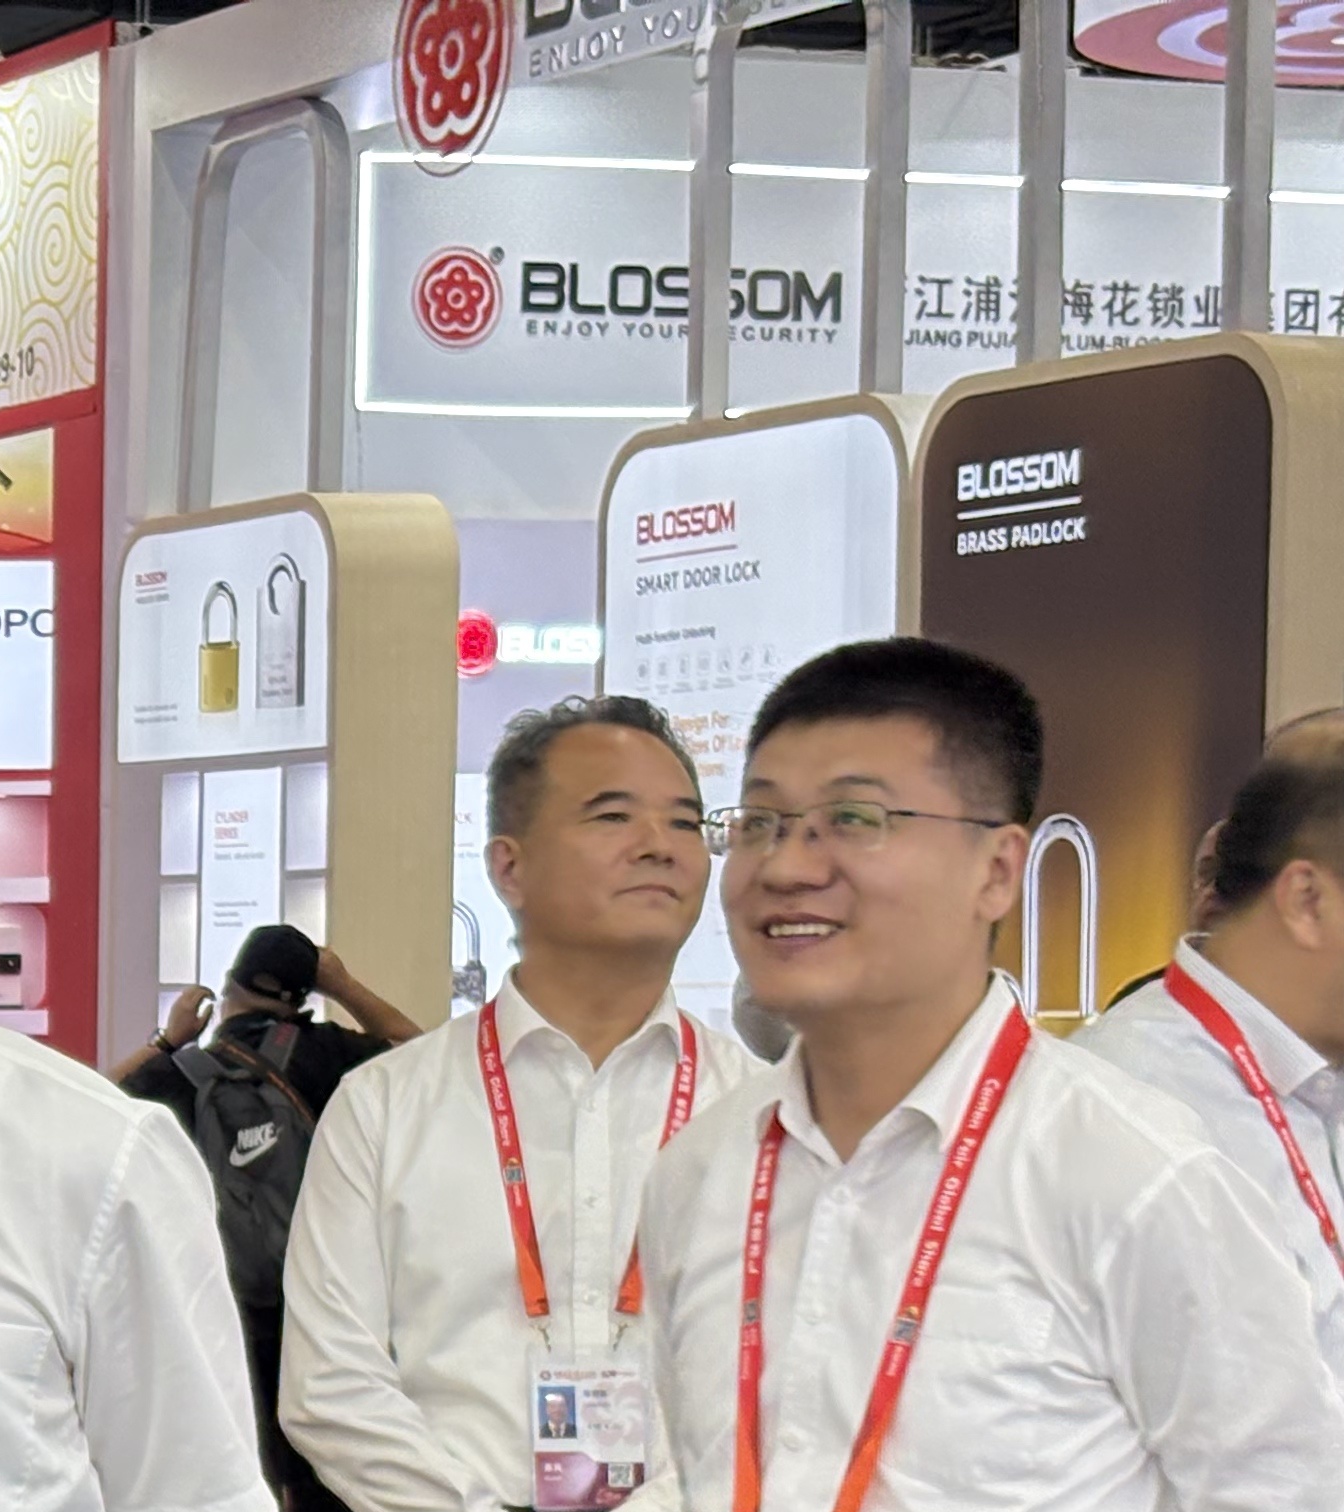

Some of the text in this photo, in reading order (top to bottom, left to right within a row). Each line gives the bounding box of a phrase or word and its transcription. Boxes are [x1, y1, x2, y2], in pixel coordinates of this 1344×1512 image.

[529, 26, 626, 79] ENJOY
[641, 2, 706, 45] YOU
[525, 319, 838, 343] ENJOY YOUR ECURITY
[967, 330, 1016, 350] PUJI
[957, 447, 1082, 501] BLOSSOM
[636, 500, 737, 546] BLOSSOM
[956, 516, 1086, 555] BRASS PADLOCK
[636, 560, 761, 597] SMART DOOR LOCK
[237, 1121, 275, 1150] NIKE
